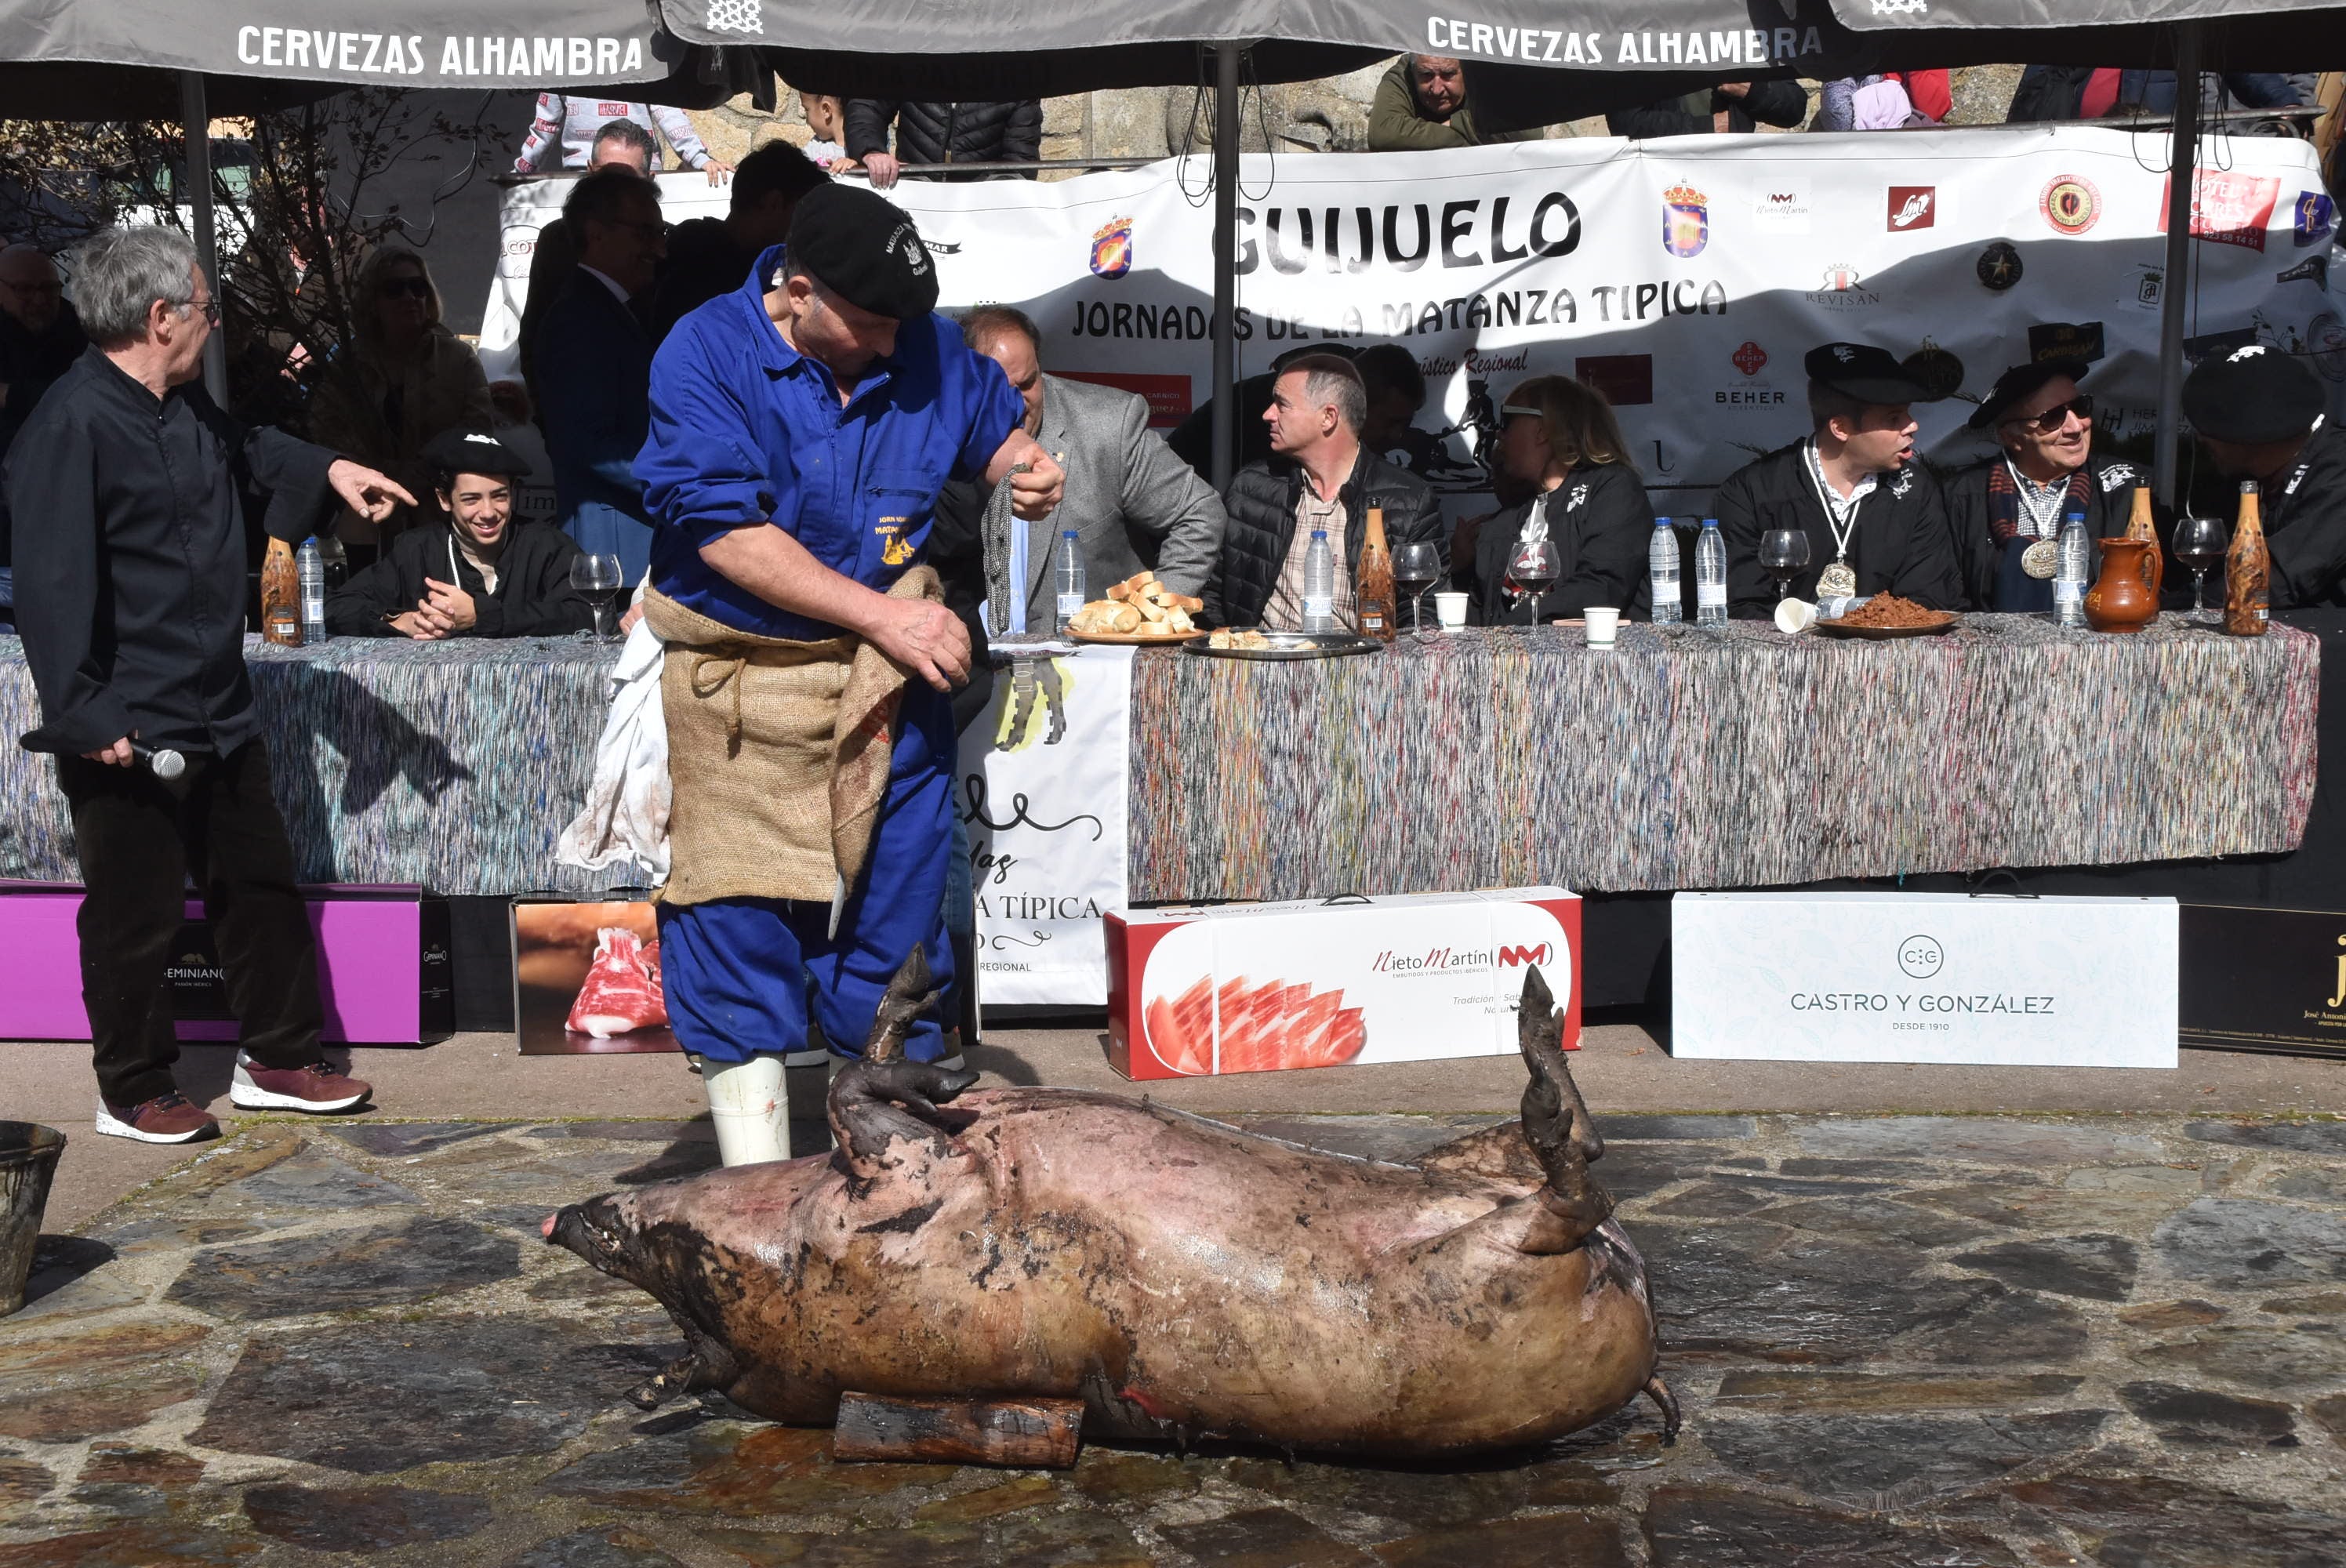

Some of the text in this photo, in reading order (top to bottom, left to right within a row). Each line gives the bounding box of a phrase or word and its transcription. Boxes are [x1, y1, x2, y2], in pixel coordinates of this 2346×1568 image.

[1427, 16, 1823, 64] CERVEZAS ALHAMBRA
[238, 25, 642, 76] CERVEZAS ALHAMBRA
[599, 103, 627, 116] MARVEL
[1211, 192, 1582, 276] GUIJUELO
[2203, 230, 2258, 247] 923 58 14 51
[924, 241, 948, 253] MAR
[1806, 292, 1880, 306] REVISAN
[1266, 307, 1309, 340] DE
[1321, 304, 1364, 339] LA
[1382, 288, 1578, 338] MATANZA
[1592, 280, 1727, 321] TIPICA
[1463, 347, 1528, 382] Regional
[1715, 391, 1785, 404] BEHER
[1000, 891, 1104, 920] TÍPICA
[980, 962, 1032, 971] REGIONAL
[1372, 949, 1422, 972] Nieto
[1423, 947, 1487, 969] Martín
[164, 967, 224, 980] EMINIAN
[1453, 994, 1494, 1006] Tradición
[1503, 993, 1521, 1002] Sab
[1791, 993, 2055, 1014] CASTRO Y GONZÁLEZ
[2304, 1010, 2346, 1021] José Antoni
[1928, 1022, 1950, 1031] 1910
